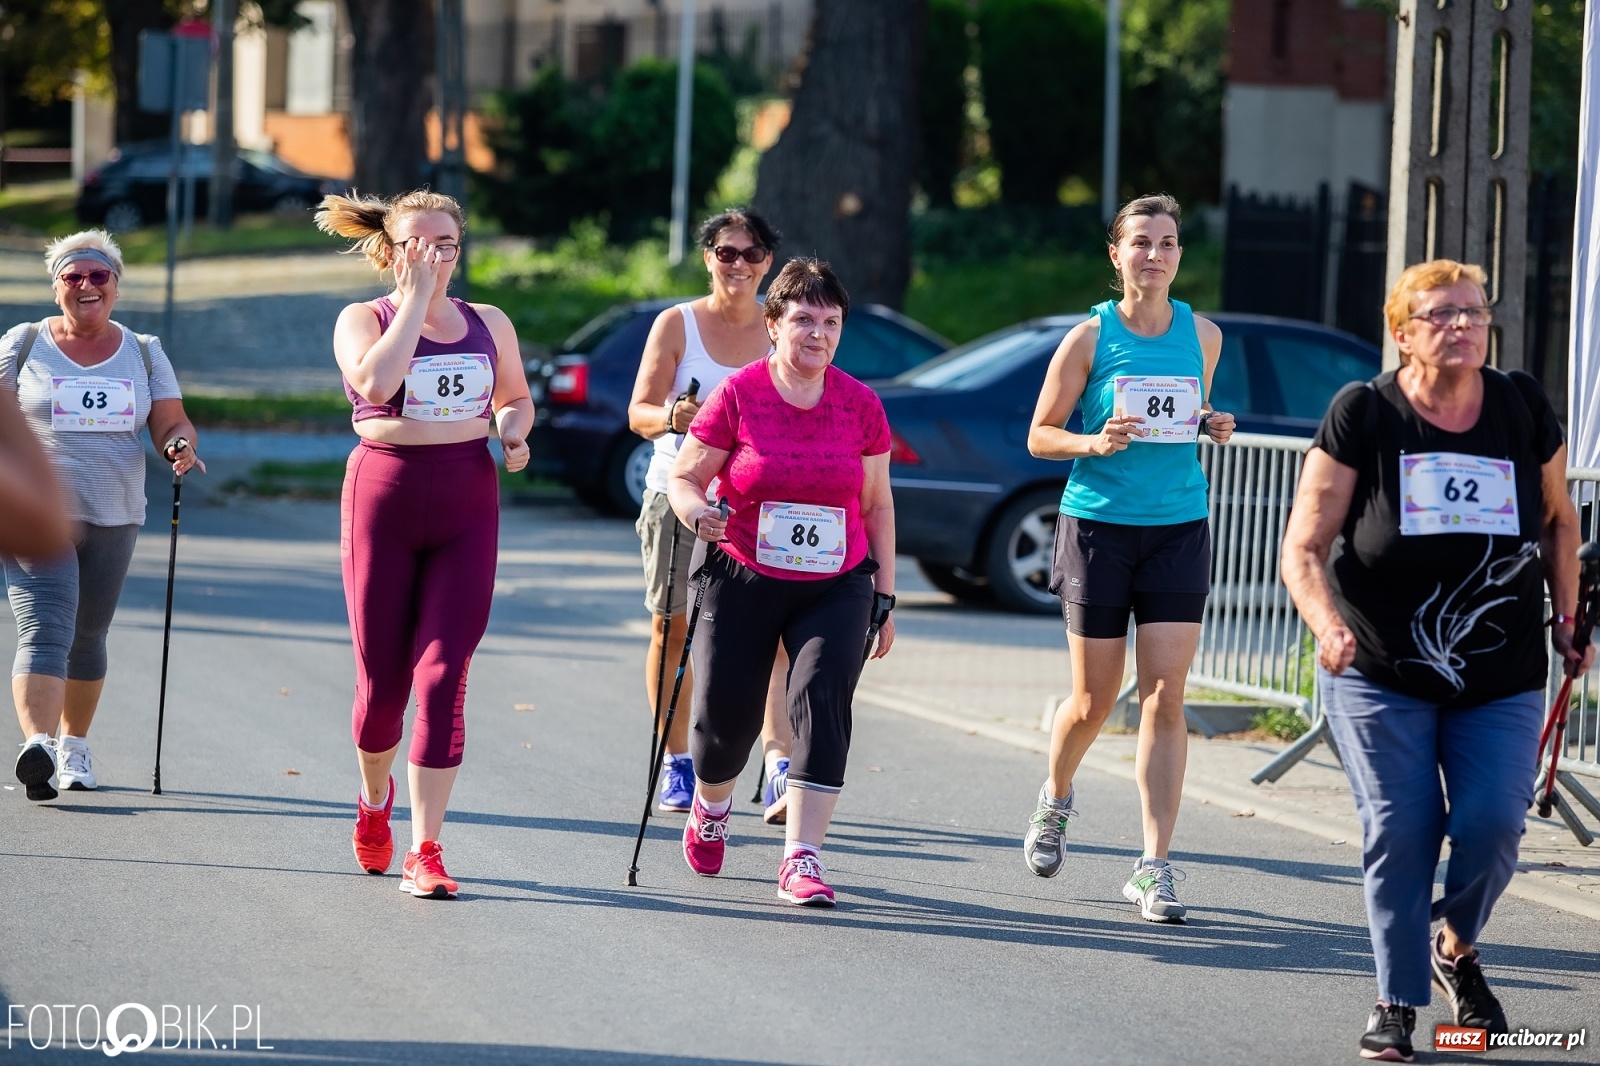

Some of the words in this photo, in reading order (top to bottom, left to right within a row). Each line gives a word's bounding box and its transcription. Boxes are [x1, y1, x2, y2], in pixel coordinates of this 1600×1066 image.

[437, 373, 465, 397] 85
[82, 390, 107, 409] 63
[1146, 395, 1175, 419] 84
[1444, 476, 1480, 503] 62
[790, 523, 820, 548] 86
[695, 573, 708, 608] newfeel
